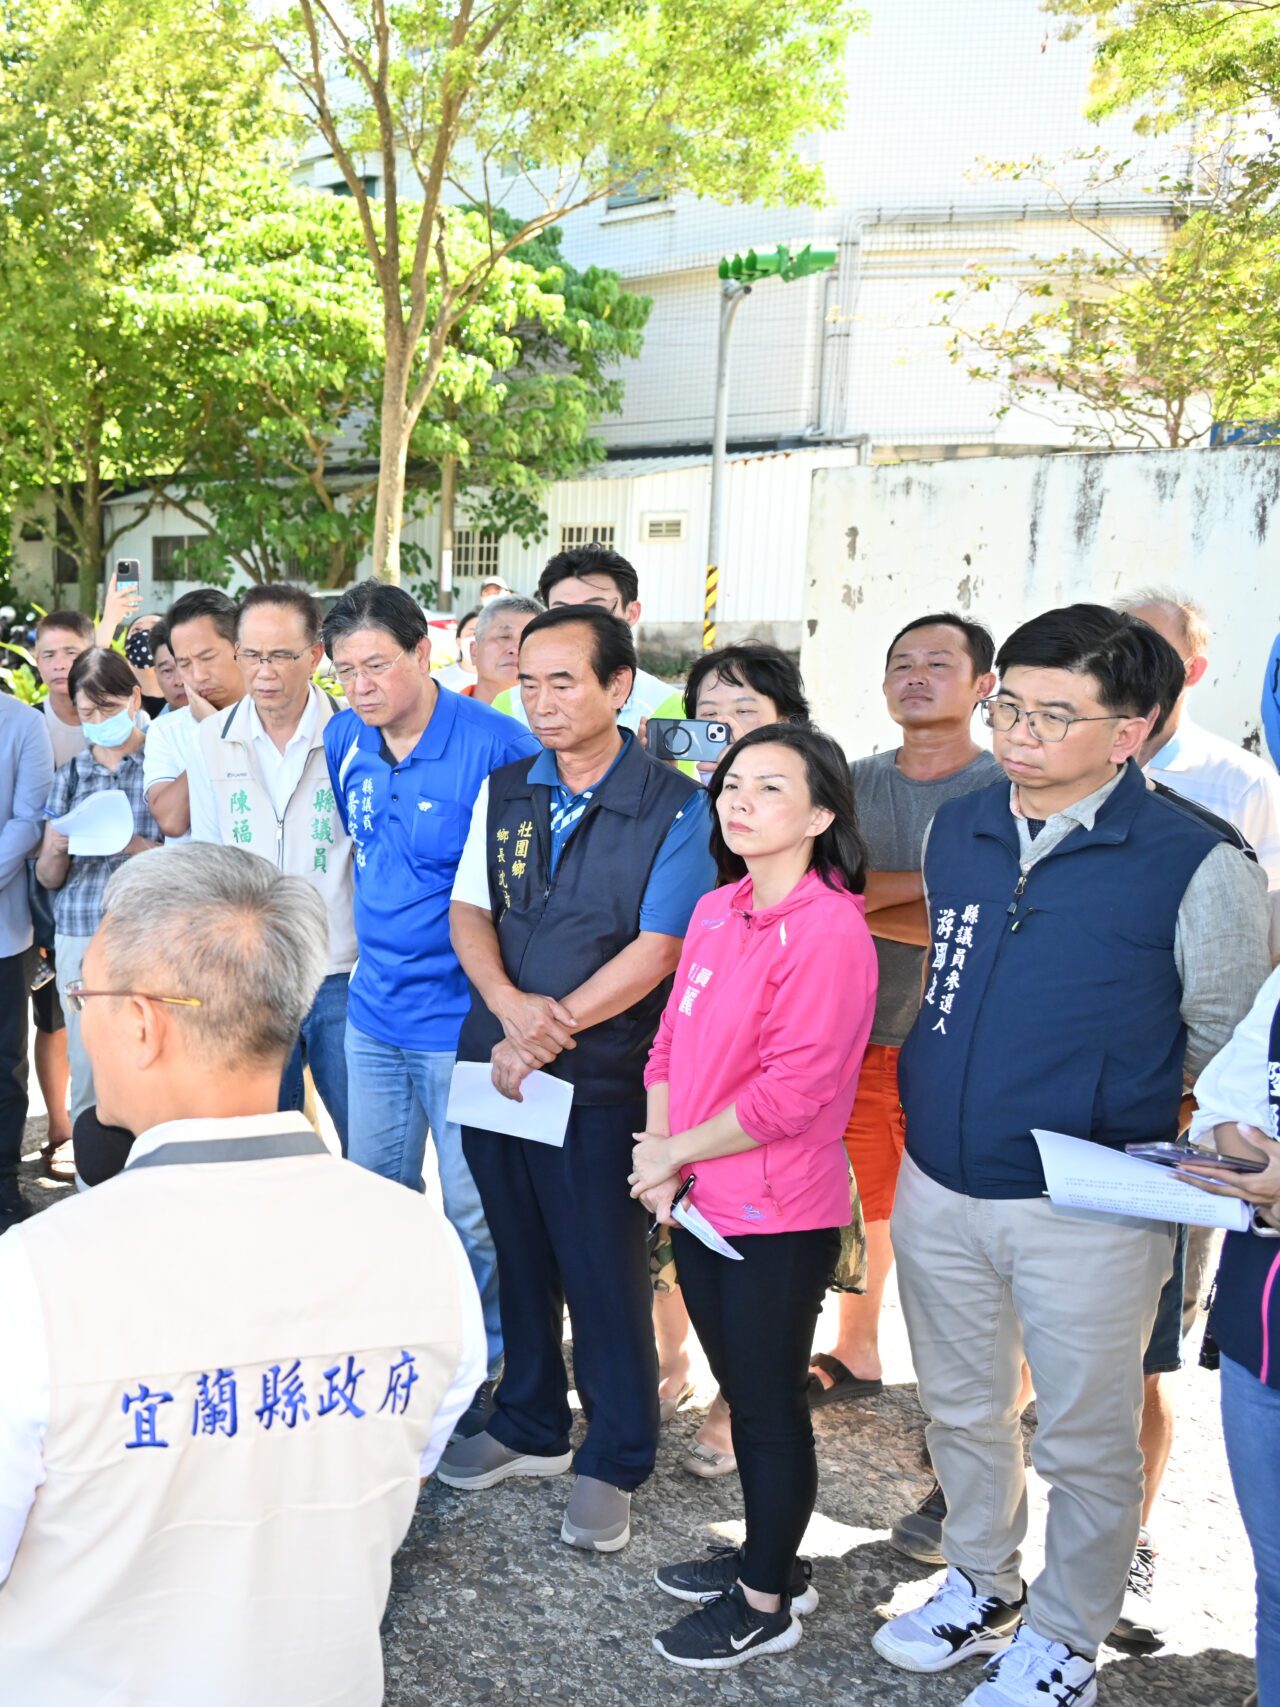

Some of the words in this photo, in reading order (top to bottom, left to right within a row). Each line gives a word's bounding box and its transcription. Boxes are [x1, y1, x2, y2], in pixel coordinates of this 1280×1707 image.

[511, 820, 533, 879] 壯圍鄉
[122, 1350, 419, 1449] 宜蘭縣政府
